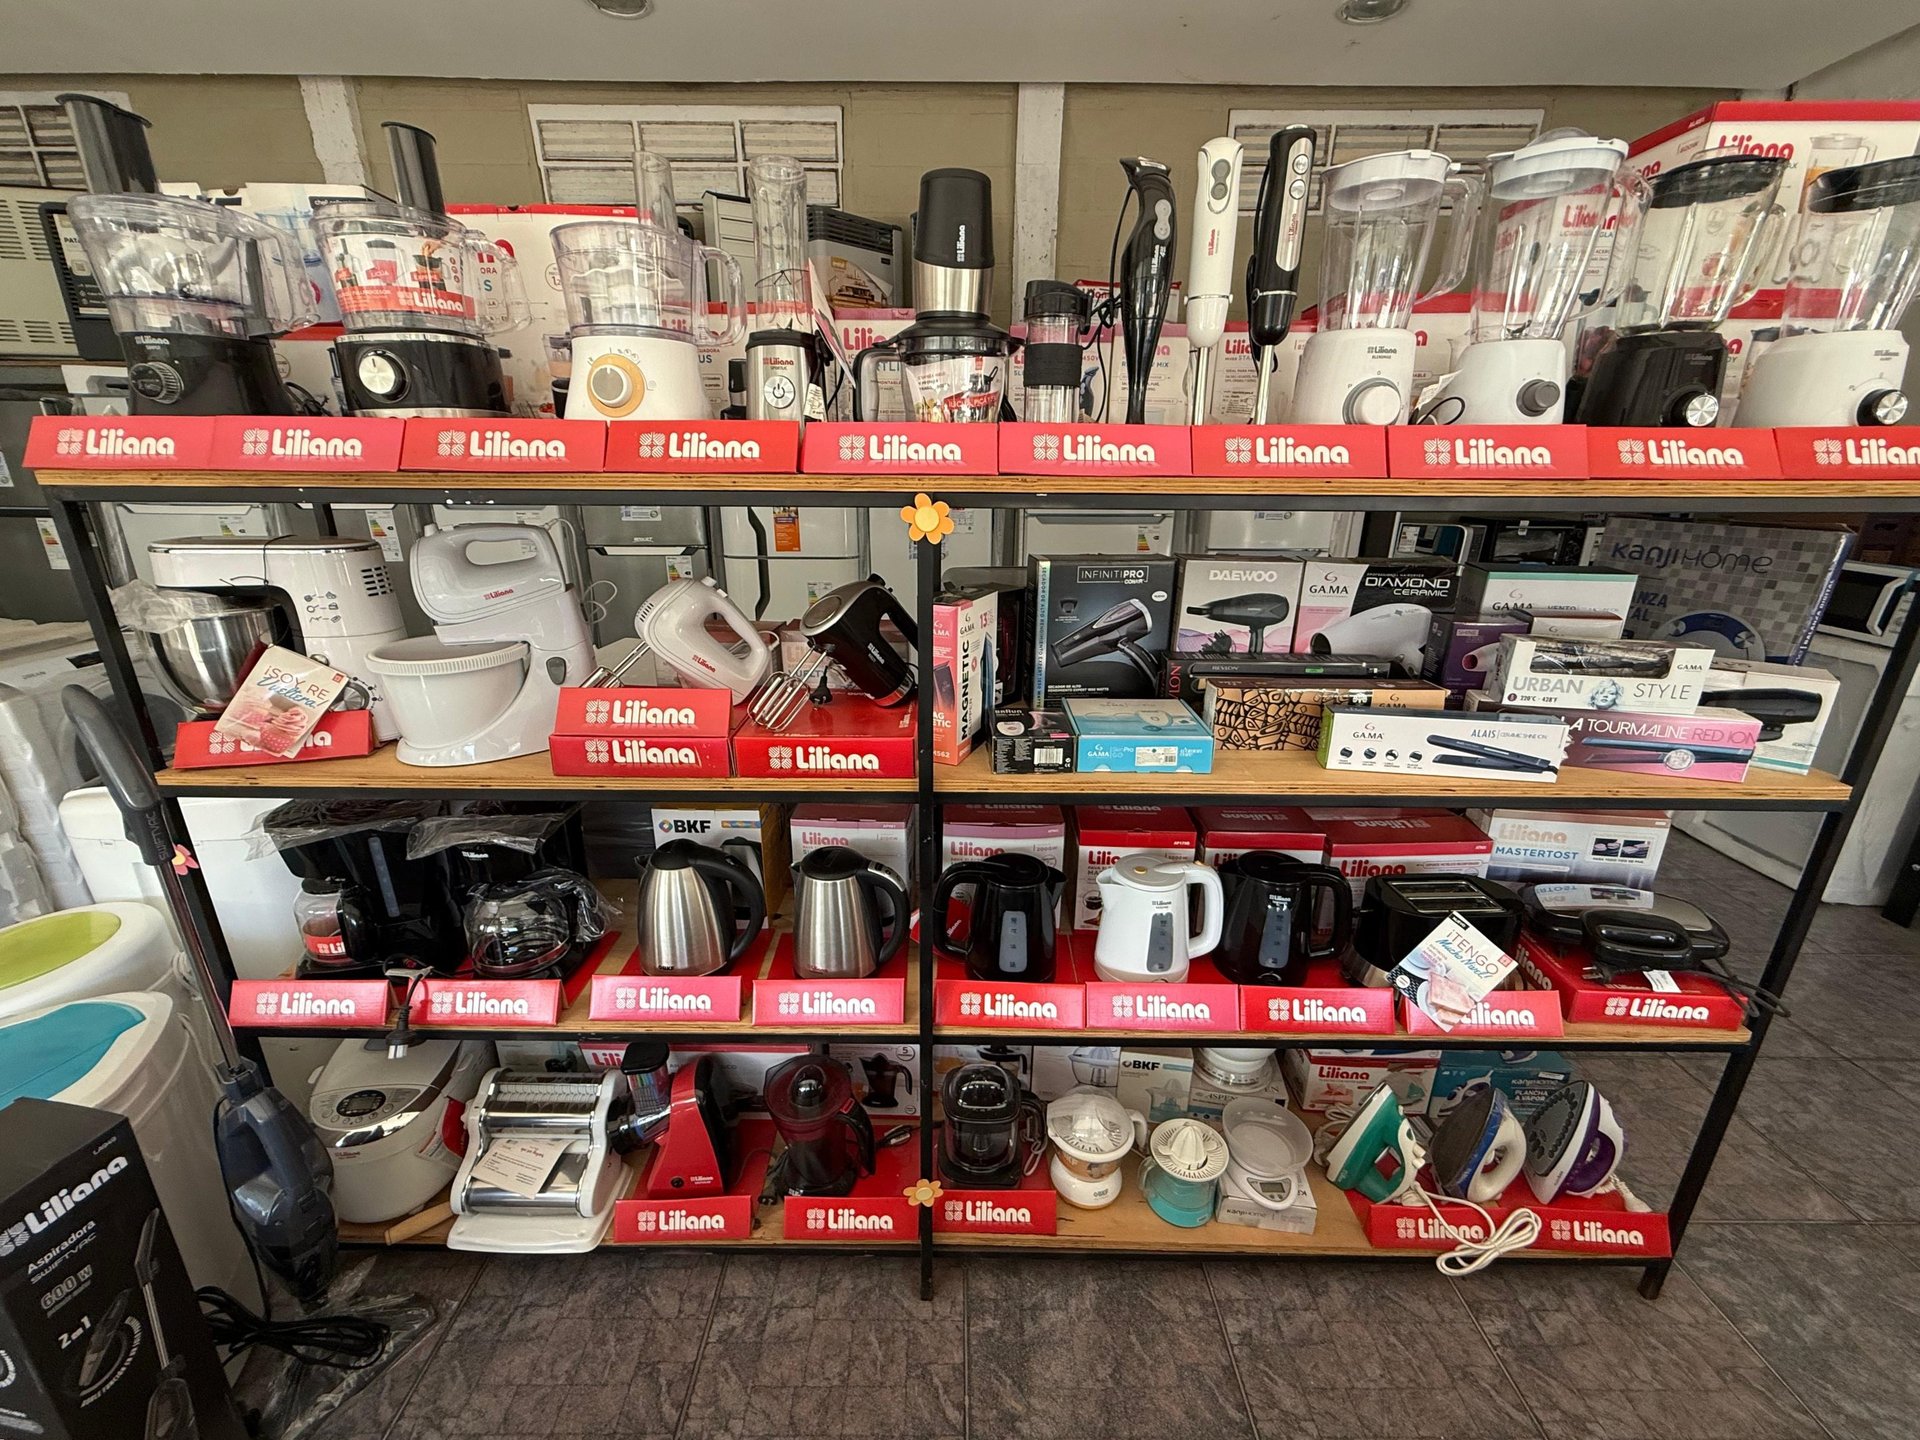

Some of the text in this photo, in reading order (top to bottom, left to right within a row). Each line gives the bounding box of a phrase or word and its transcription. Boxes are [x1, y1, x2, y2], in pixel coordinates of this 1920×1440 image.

[955, 223, 966, 254] Liliana
[412, 291, 464, 313] Liliana
[769, 357, 795, 366] Liliana
[86, 429, 175, 455] Liliana
[272, 429, 362, 456] Liliana
[470, 431, 566, 457] Liliana
[669, 432, 760, 458] Liliana
[869, 434, 962, 461] Liliana
[1063, 434, 1155, 462] Liliana
[1256, 437, 1349, 464] Liliana
[1455, 438, 1551, 465] Liliana
[1648, 439, 1744, 465] Liliana
[1846, 438, 1920, 465] Lilian
[1081, 569, 1145, 580] INFINITIPRO
[1209, 569, 1278, 583] DAEWOO
[1364, 577, 1451, 590] DIAMOND
[488, 587, 512, 598] Liliana
[1393, 588, 1449, 597] CERAMIC
[697, 656, 716, 673] Liliana
[870, 646, 885, 665] Liliana
[296, 676, 316, 692] RE
[961, 639, 970, 741] MAGNETIC
[1512, 675, 1693, 701] URBAN STYLE
[612, 700, 695, 725] Liliana
[1470, 729, 1496, 739] ALAIS
[1587, 719, 1688, 740] TOURMALINE
[1691, 727, 1725, 742] RED
[612, 740, 696, 764] Liliana
[796, 746, 879, 770] Liliana
[672, 818, 712, 834] BKF
[1500, 822, 1568, 844] Liliana
[801, 831, 849, 847] Liliana
[950, 841, 1005, 858] Liliana
[1495, 846, 1580, 861] MASTERTOST
[1341, 859, 1406, 877] Liliana
[1515, 944, 1553, 991] iliana
[281, 991, 356, 1016] Liliana
[455, 990, 528, 1015] Liliana
[639, 986, 712, 1011] Liliana
[801, 991, 876, 1016] Liliana
[984, 993, 1058, 1019] Liliana
[1135, 994, 1210, 1020] Liliana
[1292, 998, 1367, 1023] Liliana
[1629, 998, 1709, 1020] Liliana
[901, 1046, 909, 1055] 5
[1132, 1060, 1161, 1071] BKF
[1318, 1065, 1371, 1080] Liliana
[1515, 1089, 1548, 1097] PLANCHA
[24, 1153, 129, 1235] Liliana
[659, 1210, 724, 1231] Liliana
[828, 1209, 893, 1230] Liliana
[966, 1201, 1030, 1222] Liliana
[1418, 1216, 1485, 1240] Liliana
[1573, 1220, 1644, 1246] Liliana
[27, 1219, 97, 1275] Aspiradora
[30, 1231, 98, 1285] SWIFTVAC
[57, 1332, 73, 1350] 2
[80, 1314, 92, 1330] 1
